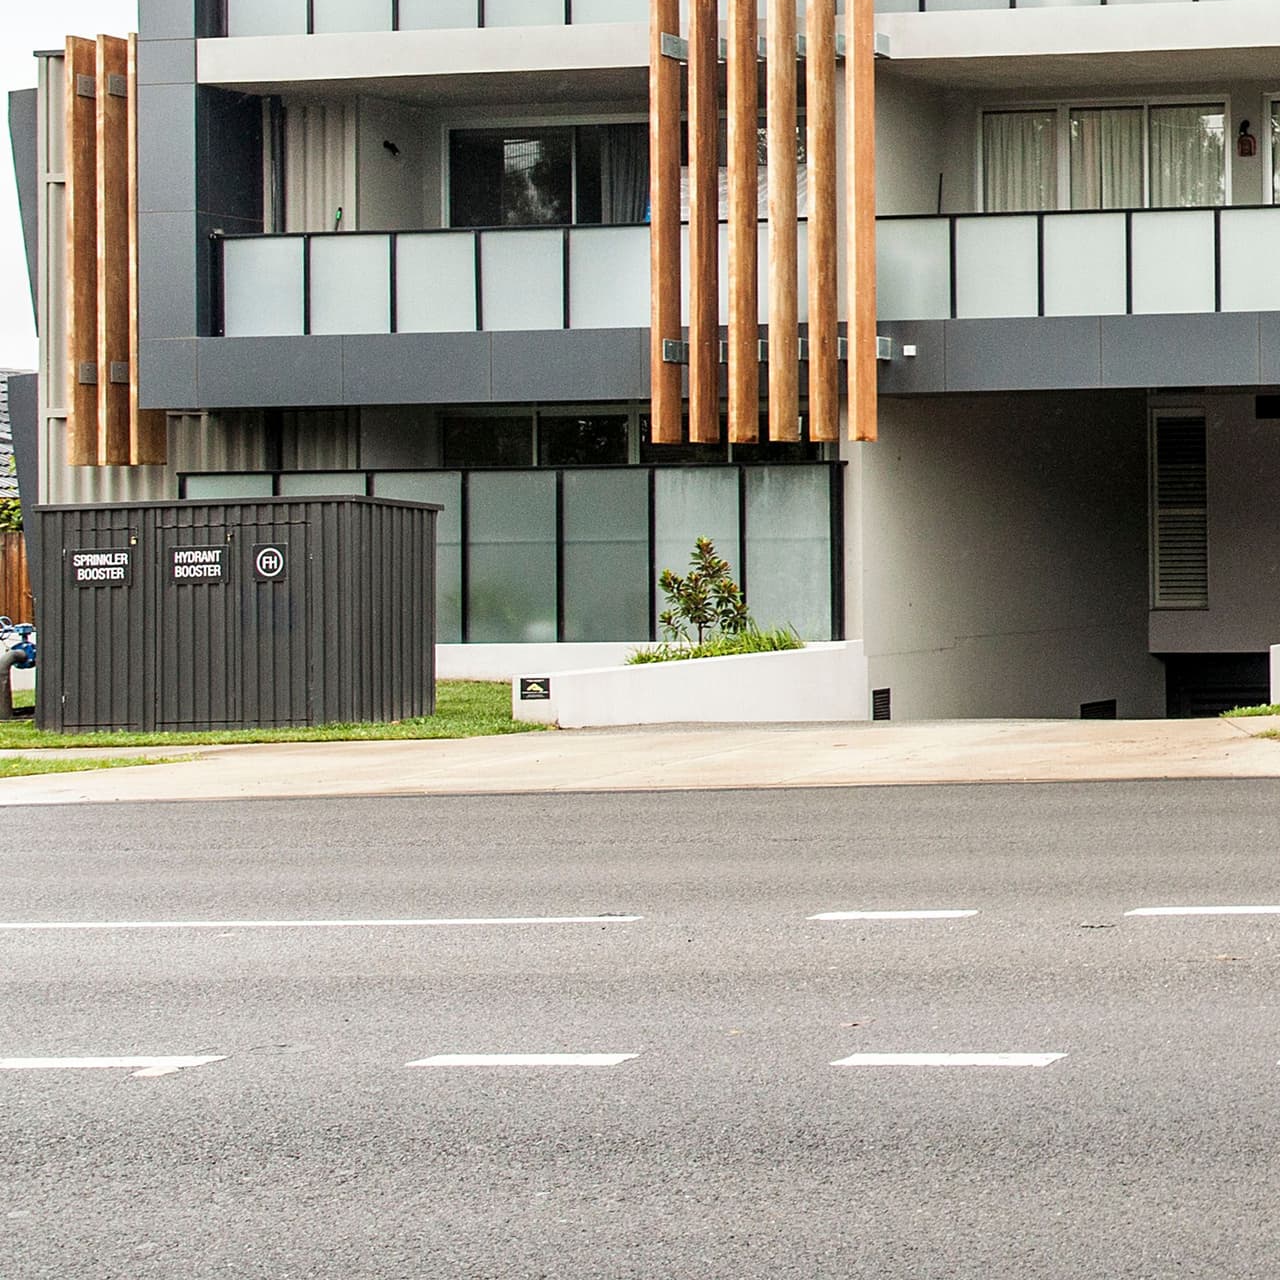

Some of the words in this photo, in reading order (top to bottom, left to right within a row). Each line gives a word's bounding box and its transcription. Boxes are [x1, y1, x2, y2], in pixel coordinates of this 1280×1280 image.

[73, 552, 129, 567] SPRINKLER
[174, 550, 221, 564] HYDRANT
[262, 555, 278, 570] FH
[77, 567, 125, 580] BOOSTER
[174, 565, 221, 578] BOOSTER
